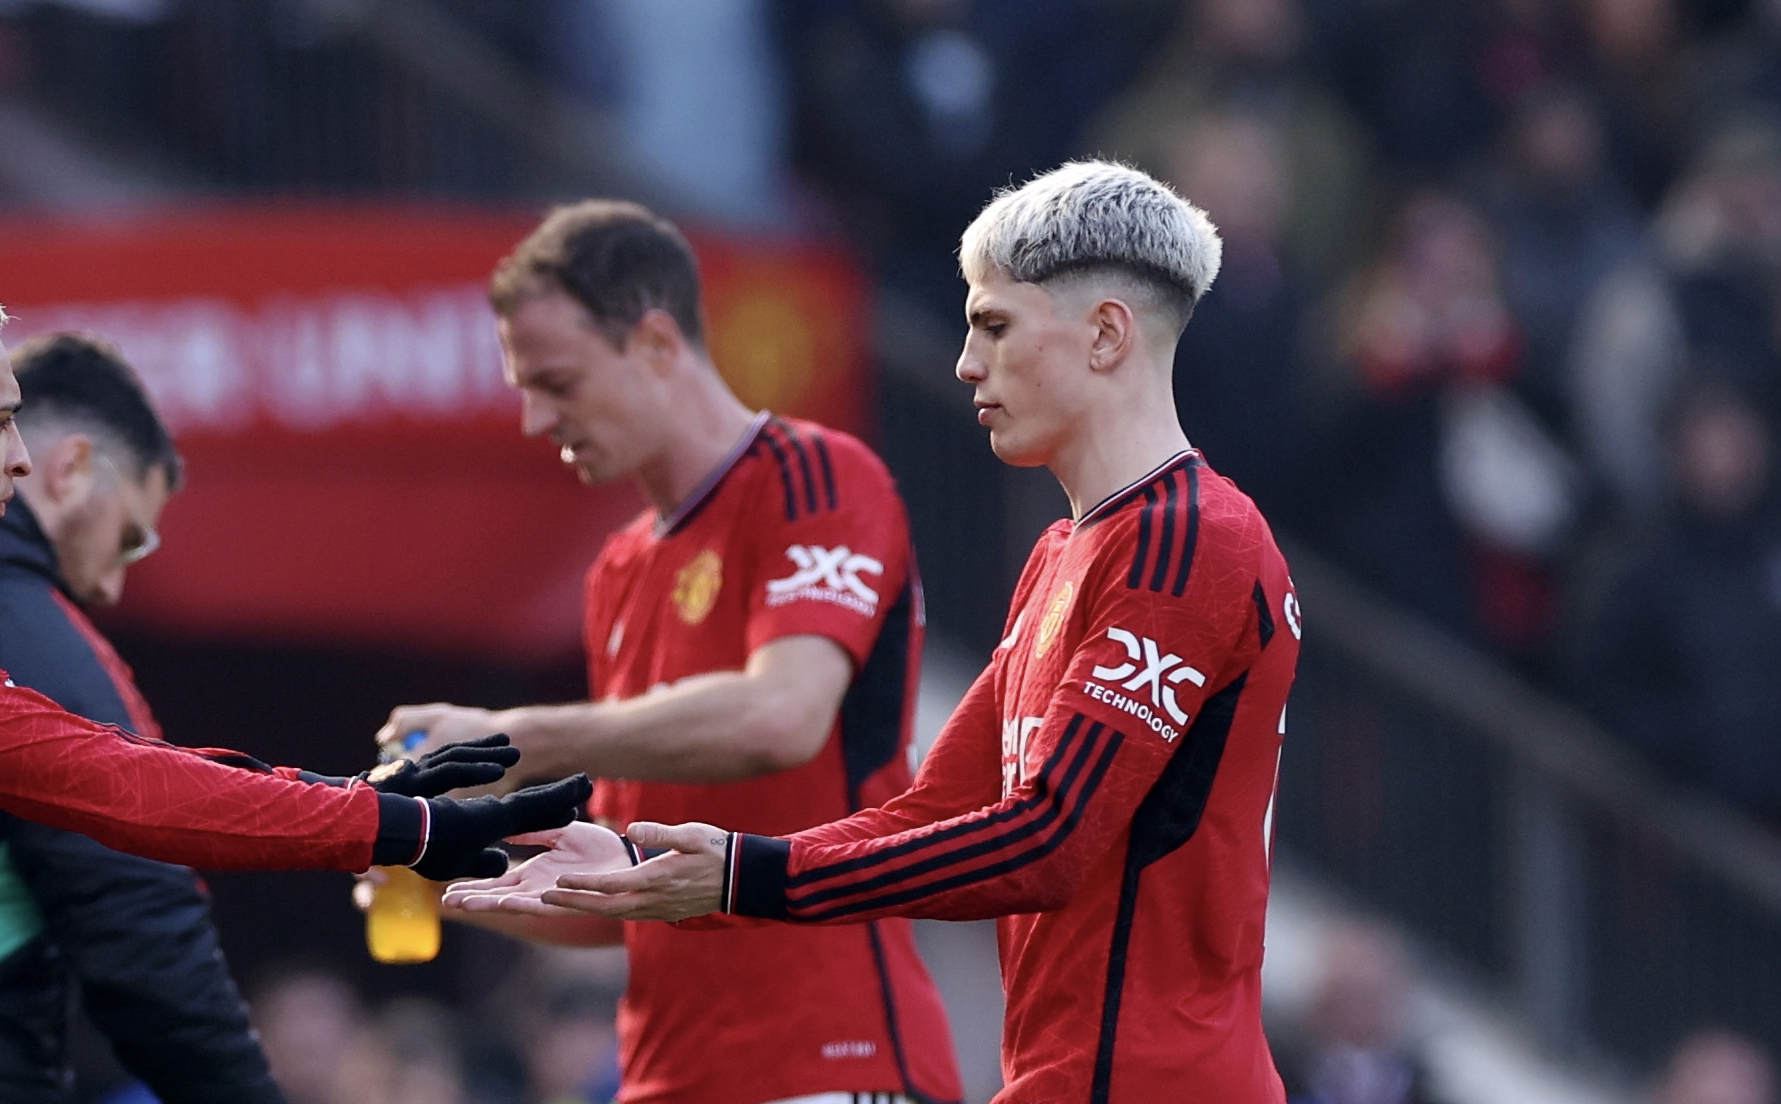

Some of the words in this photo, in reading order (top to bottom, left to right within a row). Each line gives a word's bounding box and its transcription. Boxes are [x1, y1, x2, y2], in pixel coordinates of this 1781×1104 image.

[765, 544, 884, 603] DXC
[1092, 627, 1206, 727] DXC
[1083, 681, 1179, 743] TECHNOLOGY
